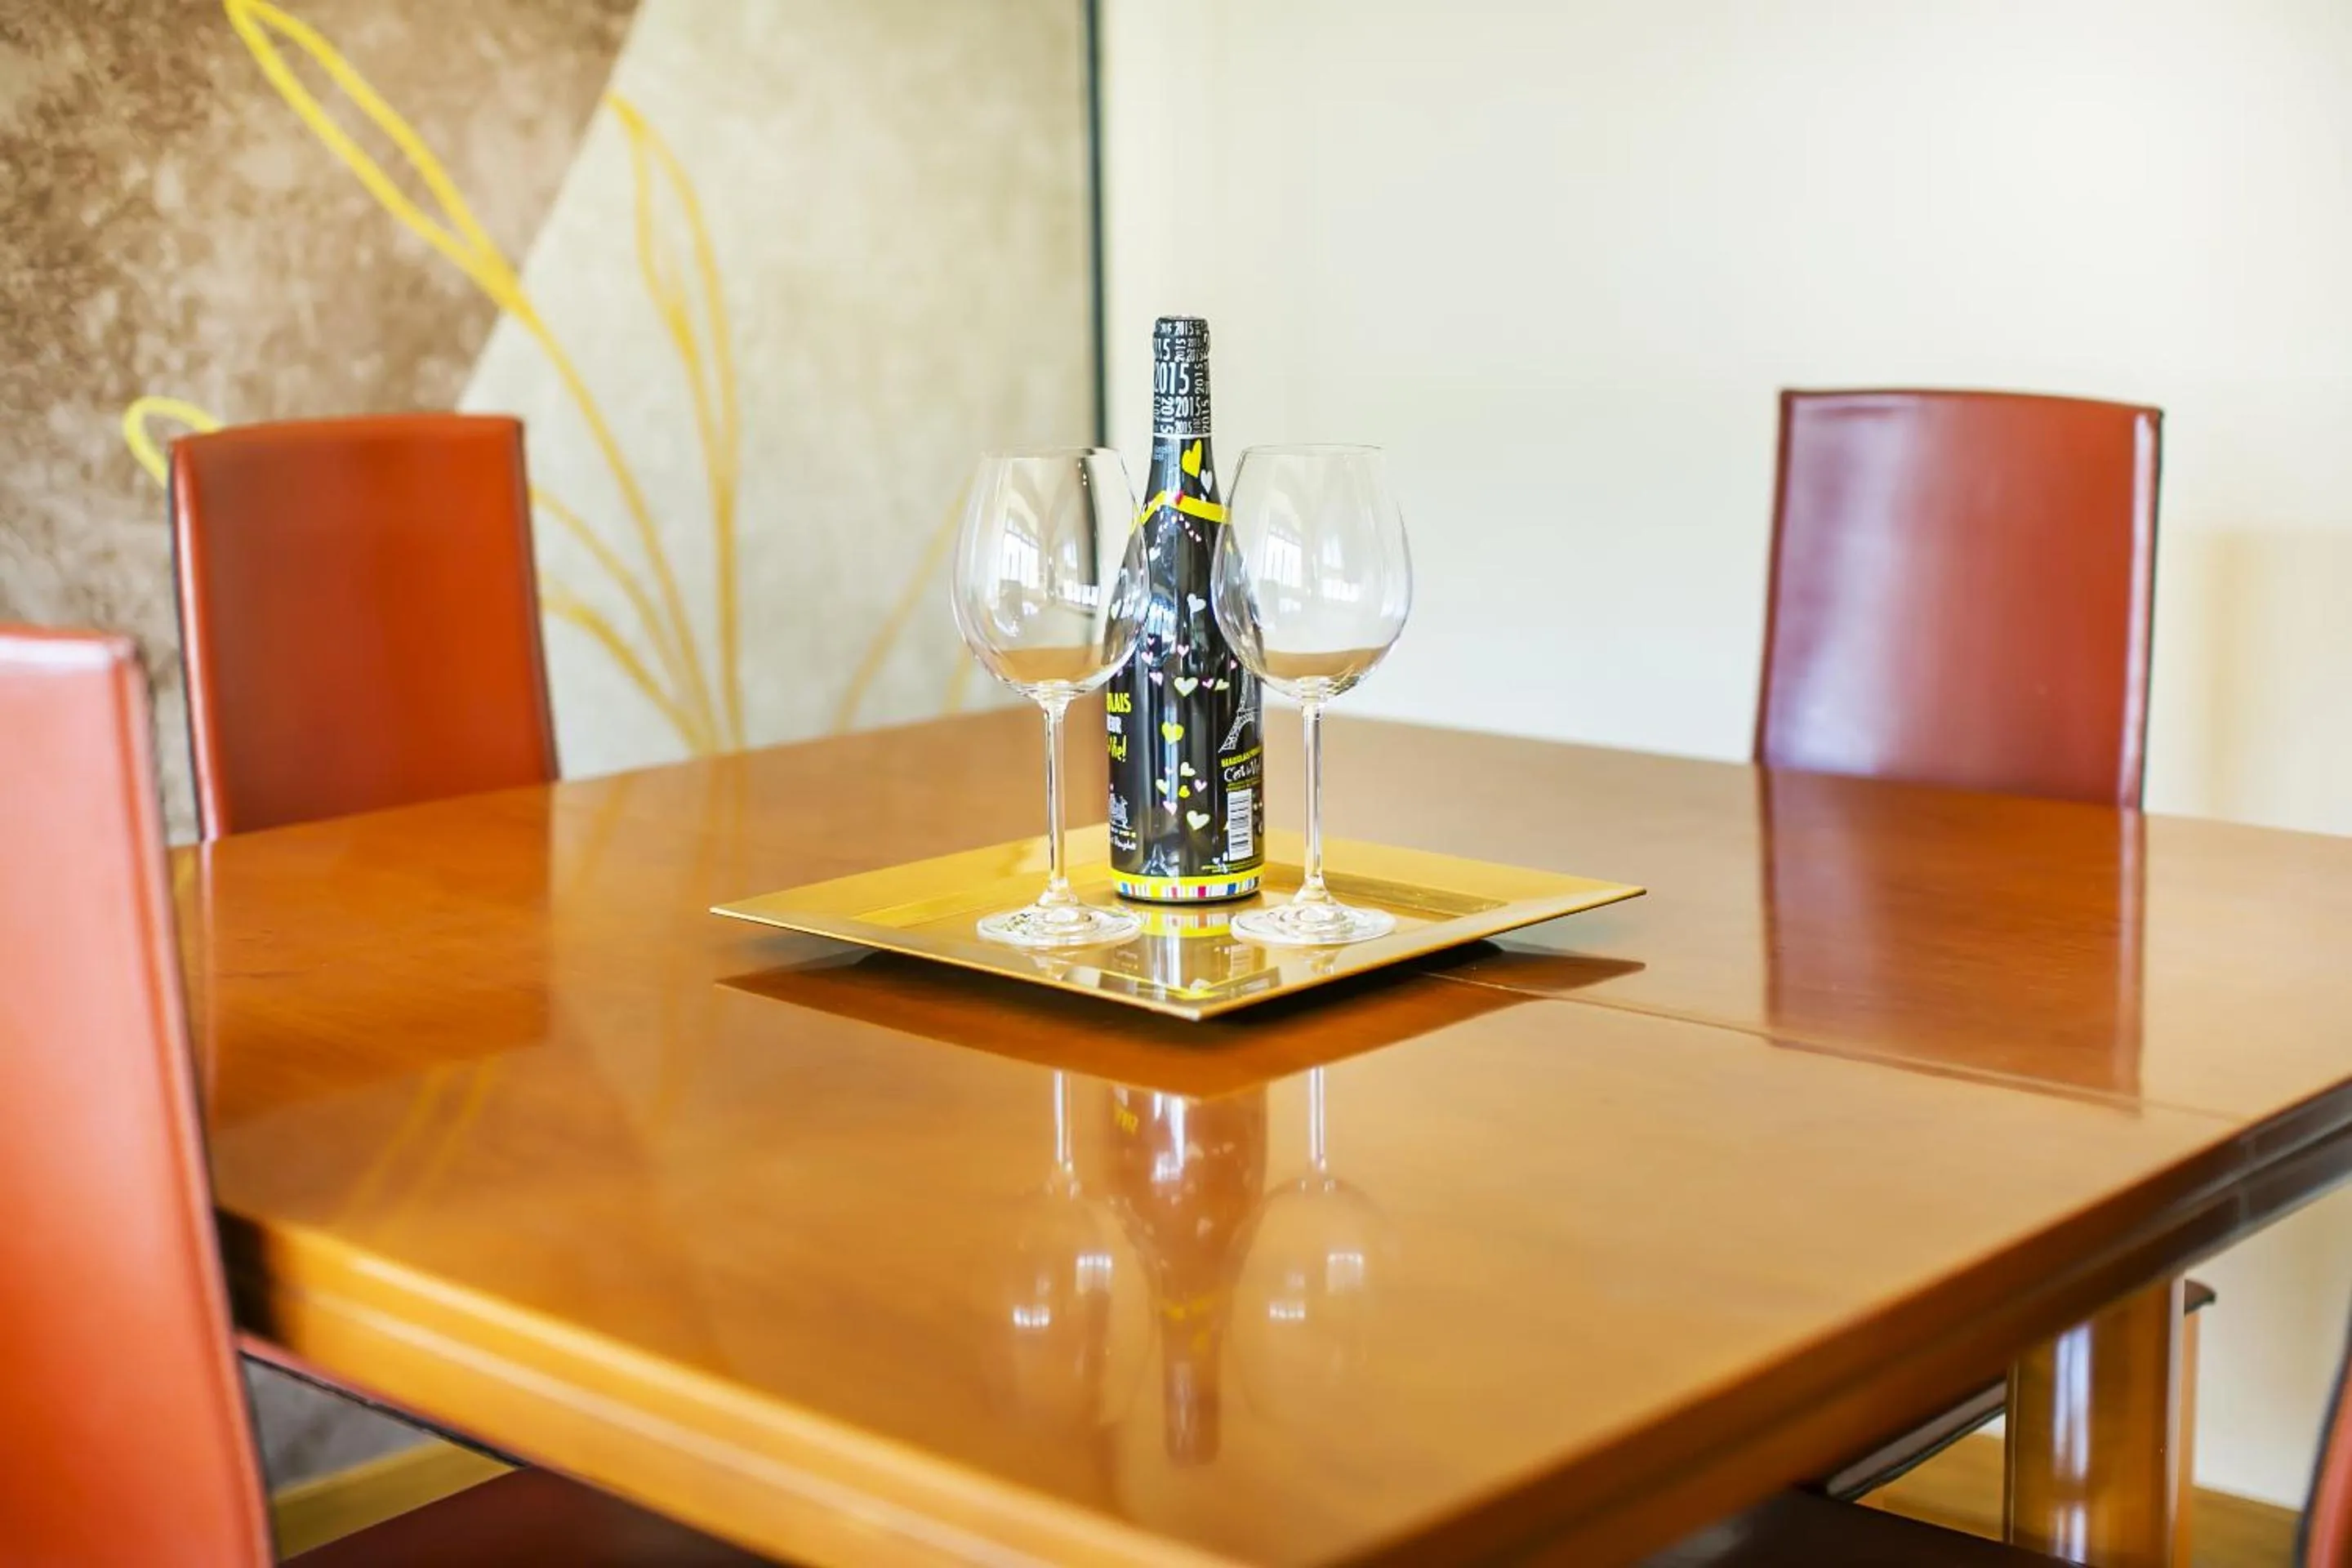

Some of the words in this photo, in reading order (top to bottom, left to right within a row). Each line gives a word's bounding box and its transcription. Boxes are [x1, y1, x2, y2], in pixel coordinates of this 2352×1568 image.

[1174, 321, 1194, 336] 2015
[1174, 338, 1186, 363] 2015
[1155, 362, 1190, 395] 2015
[1195, 363, 1204, 394] 2015
[1160, 396, 1175, 434] 2015
[1175, 396, 1201, 417] 2015
[1201, 399, 1210, 432] 2015
